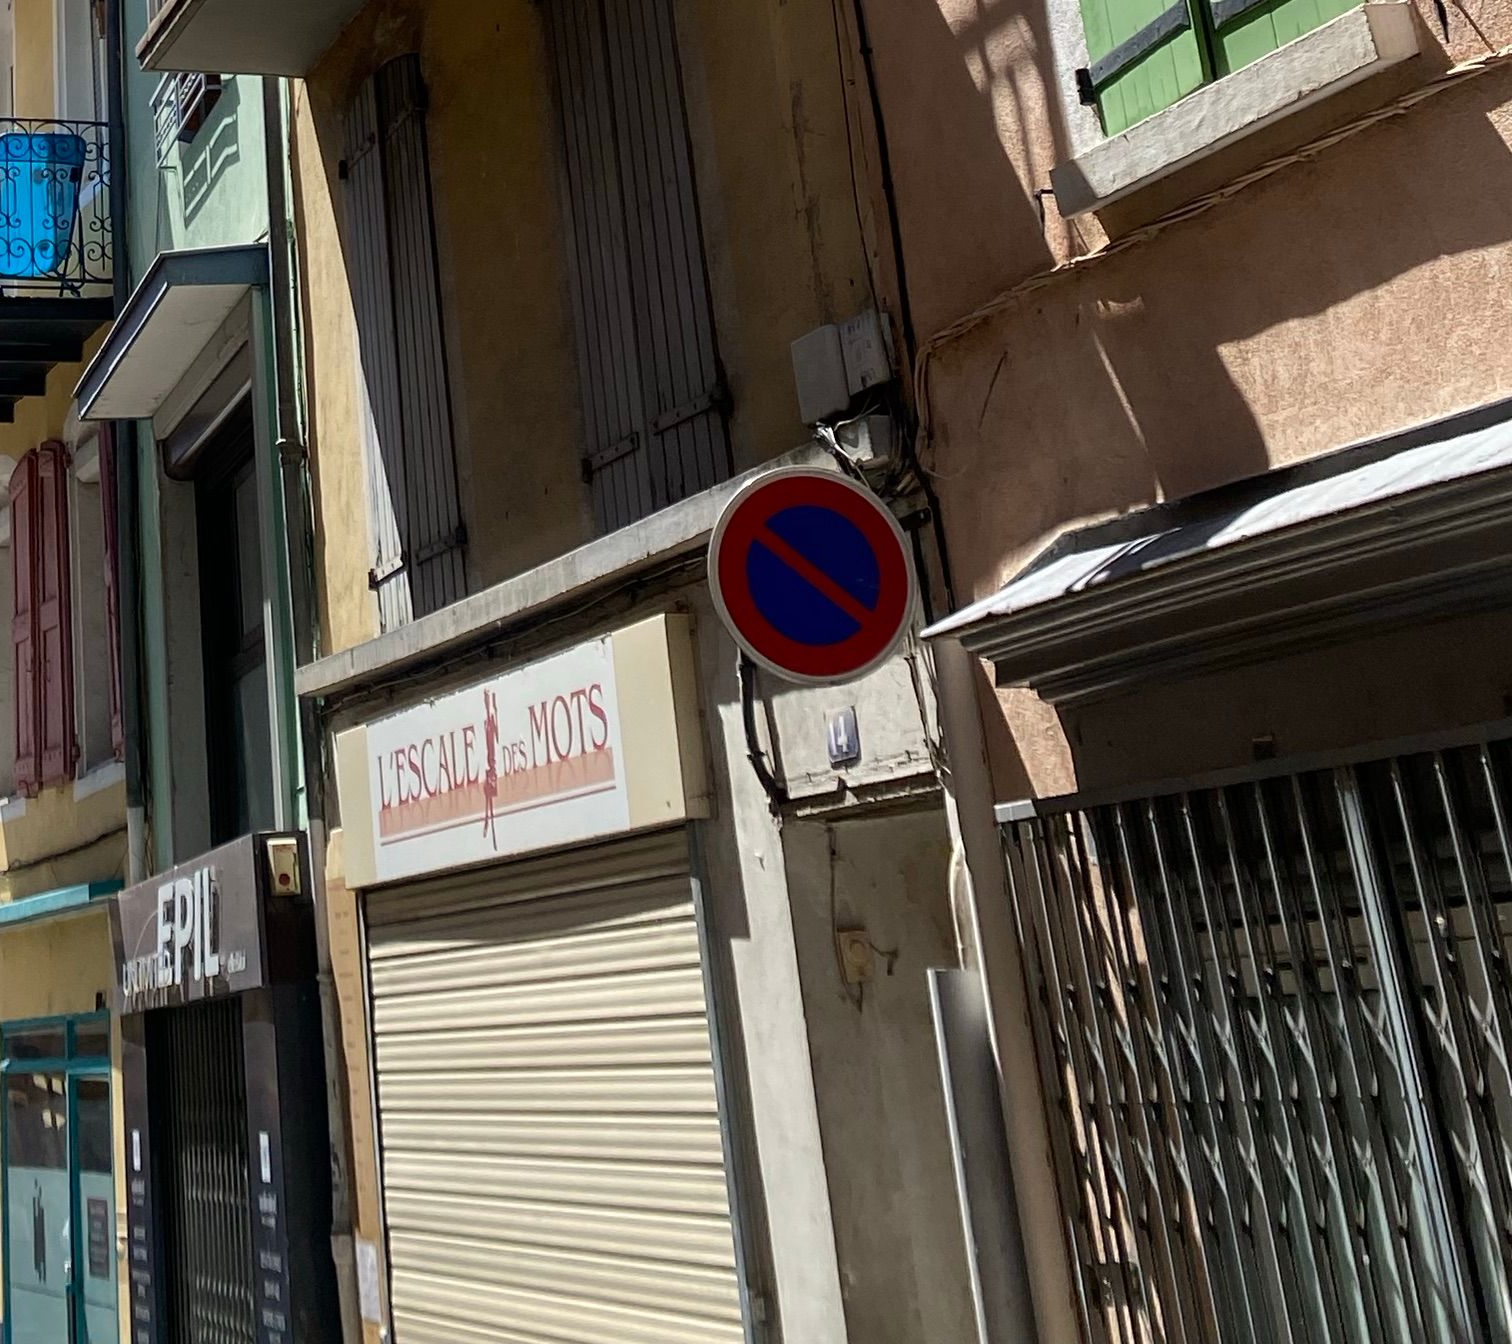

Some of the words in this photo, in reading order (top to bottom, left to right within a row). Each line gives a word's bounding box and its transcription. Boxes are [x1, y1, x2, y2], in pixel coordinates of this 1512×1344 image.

[377, 725, 480, 811] L'ESCALE
[502, 740, 528, 776] DES
[527, 683, 608, 769] MOTS
[829, 716, 849, 756] 14
[157, 867, 220, 989] EPIL
